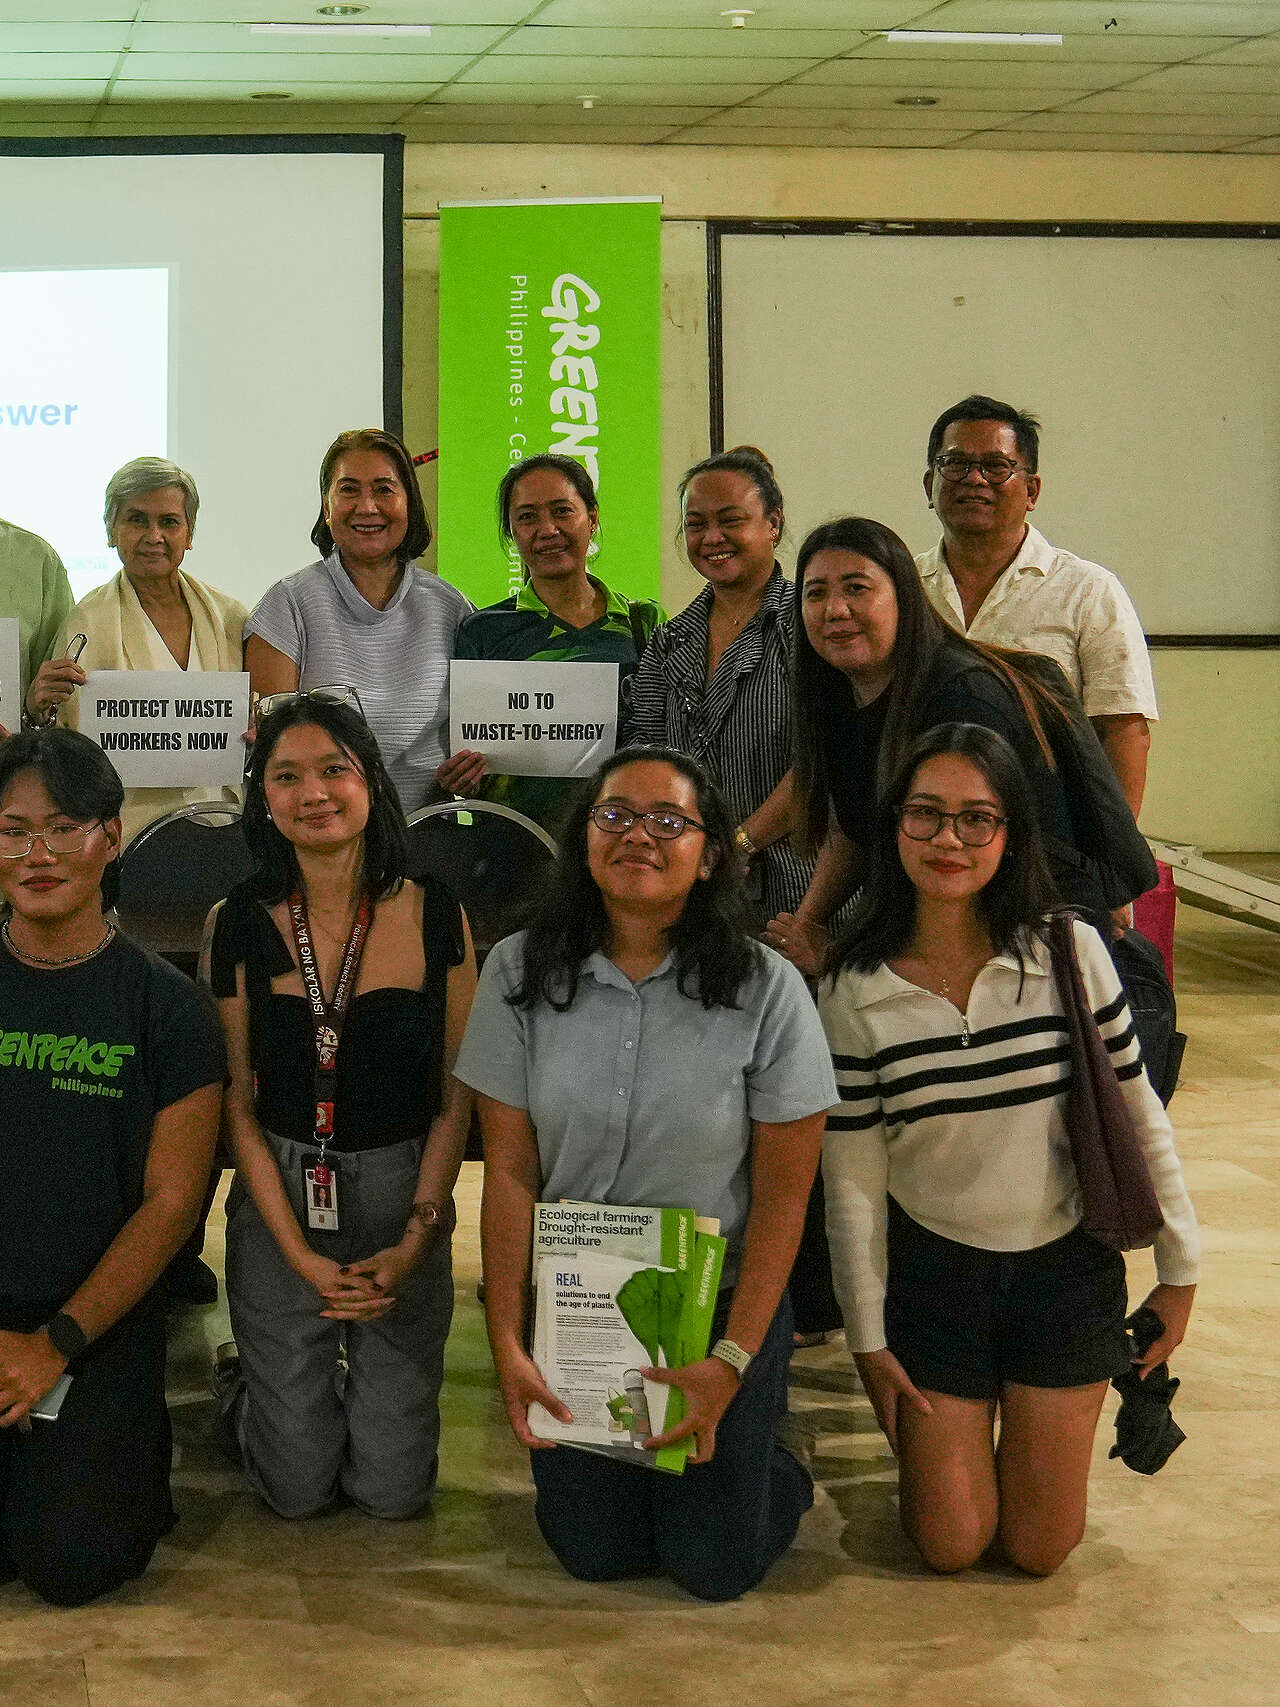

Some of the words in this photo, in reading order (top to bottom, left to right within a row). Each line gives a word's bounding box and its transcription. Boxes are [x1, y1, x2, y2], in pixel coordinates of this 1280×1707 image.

[506, 275, 528, 407] Philippines
[96, 699, 169, 719] PROTECT
[175, 699, 233, 718] WASTE
[508, 692, 529, 710] NO
[534, 692, 554, 710] TO
[461, 723, 605, 741] WASTE-TO-ENERGY
[100, 732, 182, 751] WORKERS
[187, 732, 228, 750] NOW
[292, 904, 309, 945] BAYAN
[301, 946, 314, 964] NG
[51, 1077, 124, 1099] Philippines
[539, 1208, 600, 1223] Ecological
[603, 1211, 653, 1225] farming:
[539, 1221, 643, 1236] Drought-resistant
[538, 1234, 602, 1247] agriculture
[556, 1272, 583, 1287] REAL
[556, 1290, 587, 1299] solutions
[589, 1291, 596, 1299] to
[598, 1292, 611, 1300] end
[569, 1301, 581, 1309] age
[592, 1301, 615, 1310] plastic
